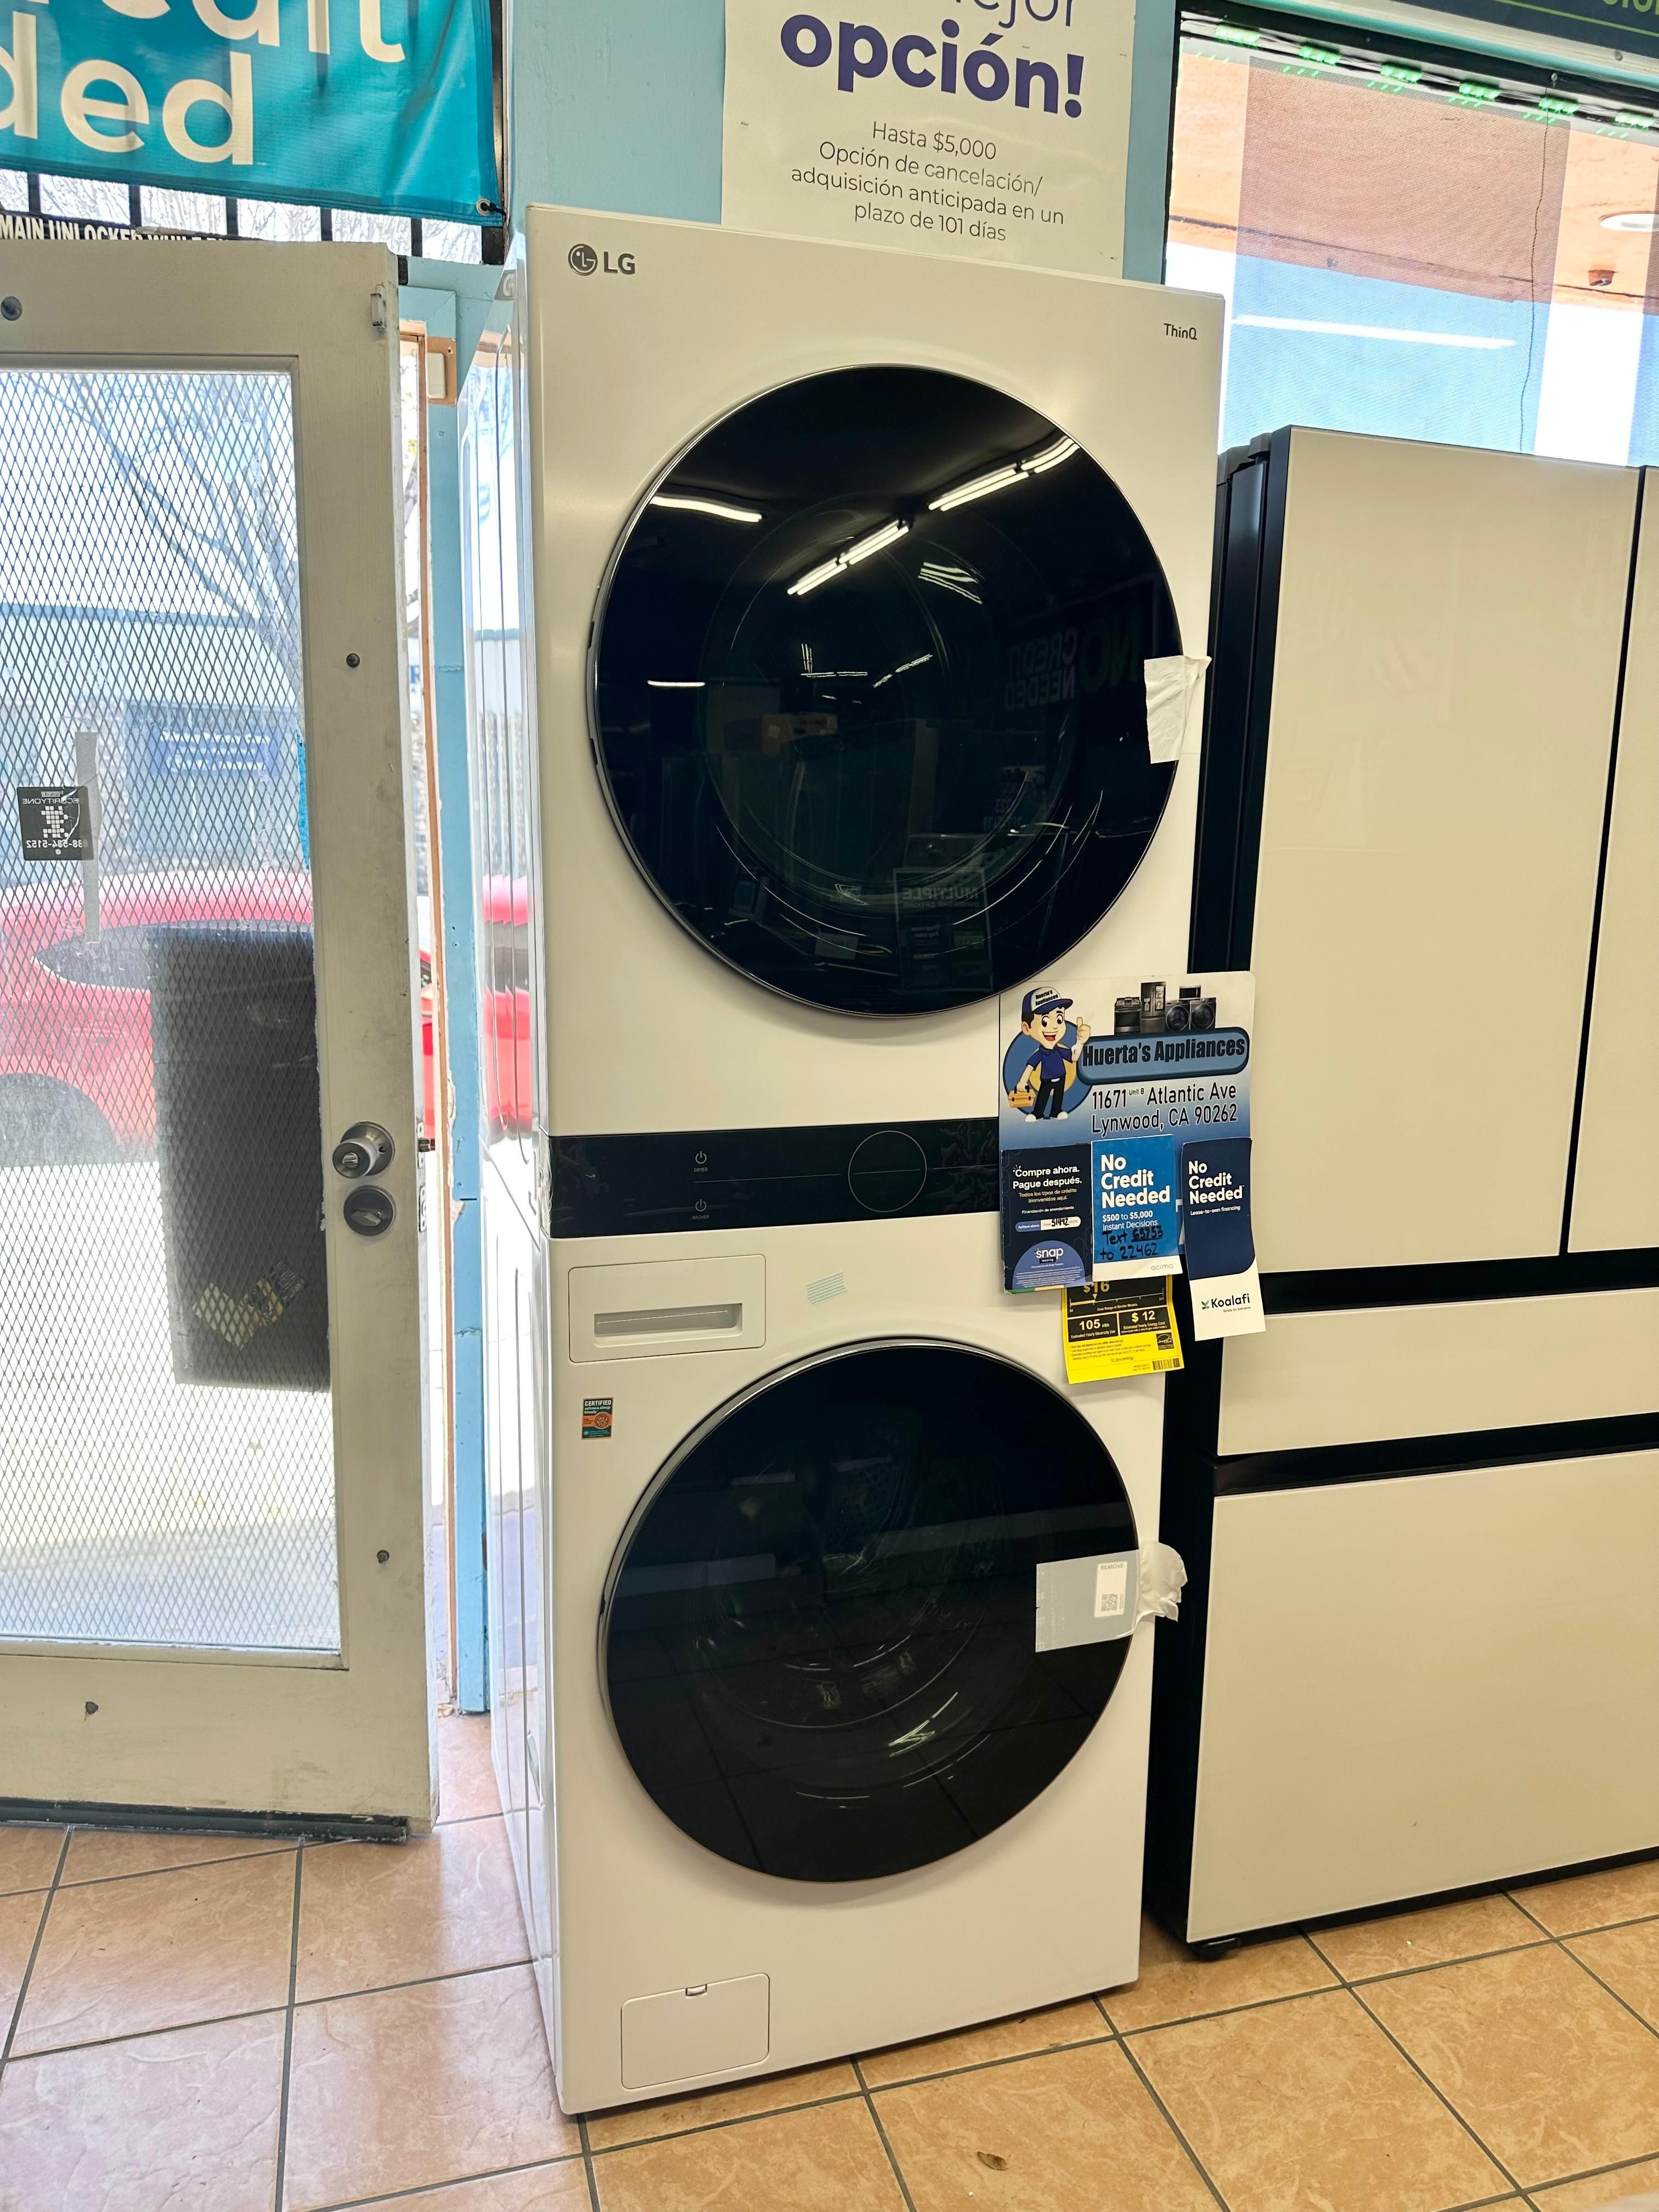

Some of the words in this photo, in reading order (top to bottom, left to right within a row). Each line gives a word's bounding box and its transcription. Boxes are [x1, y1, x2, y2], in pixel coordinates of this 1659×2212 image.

[780, 14, 1085, 118] opción!
[873, 121, 927, 148] Hasta
[933, 131, 996, 160] $5,000
[820, 141, 889, 170] Opción
[895, 154, 919, 174] de
[924, 163, 1043, 197] cancelación/
[792, 167, 902, 199] adquisición
[909, 188, 1007, 216] anticipada
[1012, 205, 1034, 221] en
[1041, 209, 1064, 225] un
[855, 202, 905, 225] plazo
[910, 210, 934, 229] de
[939, 215, 963, 235] 101
[969, 220, 1006, 241] días
[603, 251, 635, 275] LG
[1164, 323, 1198, 340] ThinQ
[1082, 1042, 1151, 1066] Huerta's
[1154, 1039, 1245, 1062] Appliances
[1092, 1088, 1126, 1110] 11671
[1147, 1083, 1205, 1106] Atlantic
[1209, 1081, 1237, 1101] Ave
[1092, 1109, 1164, 1137] Lynwood,
[1169, 1107, 1189, 1126] CA
[1194, 1103, 1237, 1125] 90262
[1015, 1169, 1051, 1178] Compre
[1053, 1166, 1080, 1174] ahora.
[1101, 1154, 1126, 1172] No
[1188, 1160, 1207, 1175] No
[1013, 1181, 1041, 1190] Pague
[1043, 1176, 1082, 1187] después.
[1101, 1169, 1154, 1190] Credit
[1188, 1172, 1233, 1190] Credit
[1102, 1185, 1171, 1209] Needed
[1189, 1185, 1243, 1205] Needed
[1102, 1213, 1120, 1222] $500
[1130, 1210, 1153, 1220] $5,000
[1103, 1222, 1125, 1232] Instant
[1126, 1220, 1158, 1229] Decisions
[1102, 1230, 1128, 1246] Text
[1036, 1248, 1064, 1260] snap
[1099, 1248, 1114, 1261] to
[1119, 1242, 1159, 1260] 22462
[1150, 1263, 1174, 1271] acima
[1211, 1293, 1250, 1308] Koalafi
[1079, 1318, 1101, 1331] 105
[1131, 1312, 1139, 1323] $
[1142, 1310, 1156, 1322] 12
